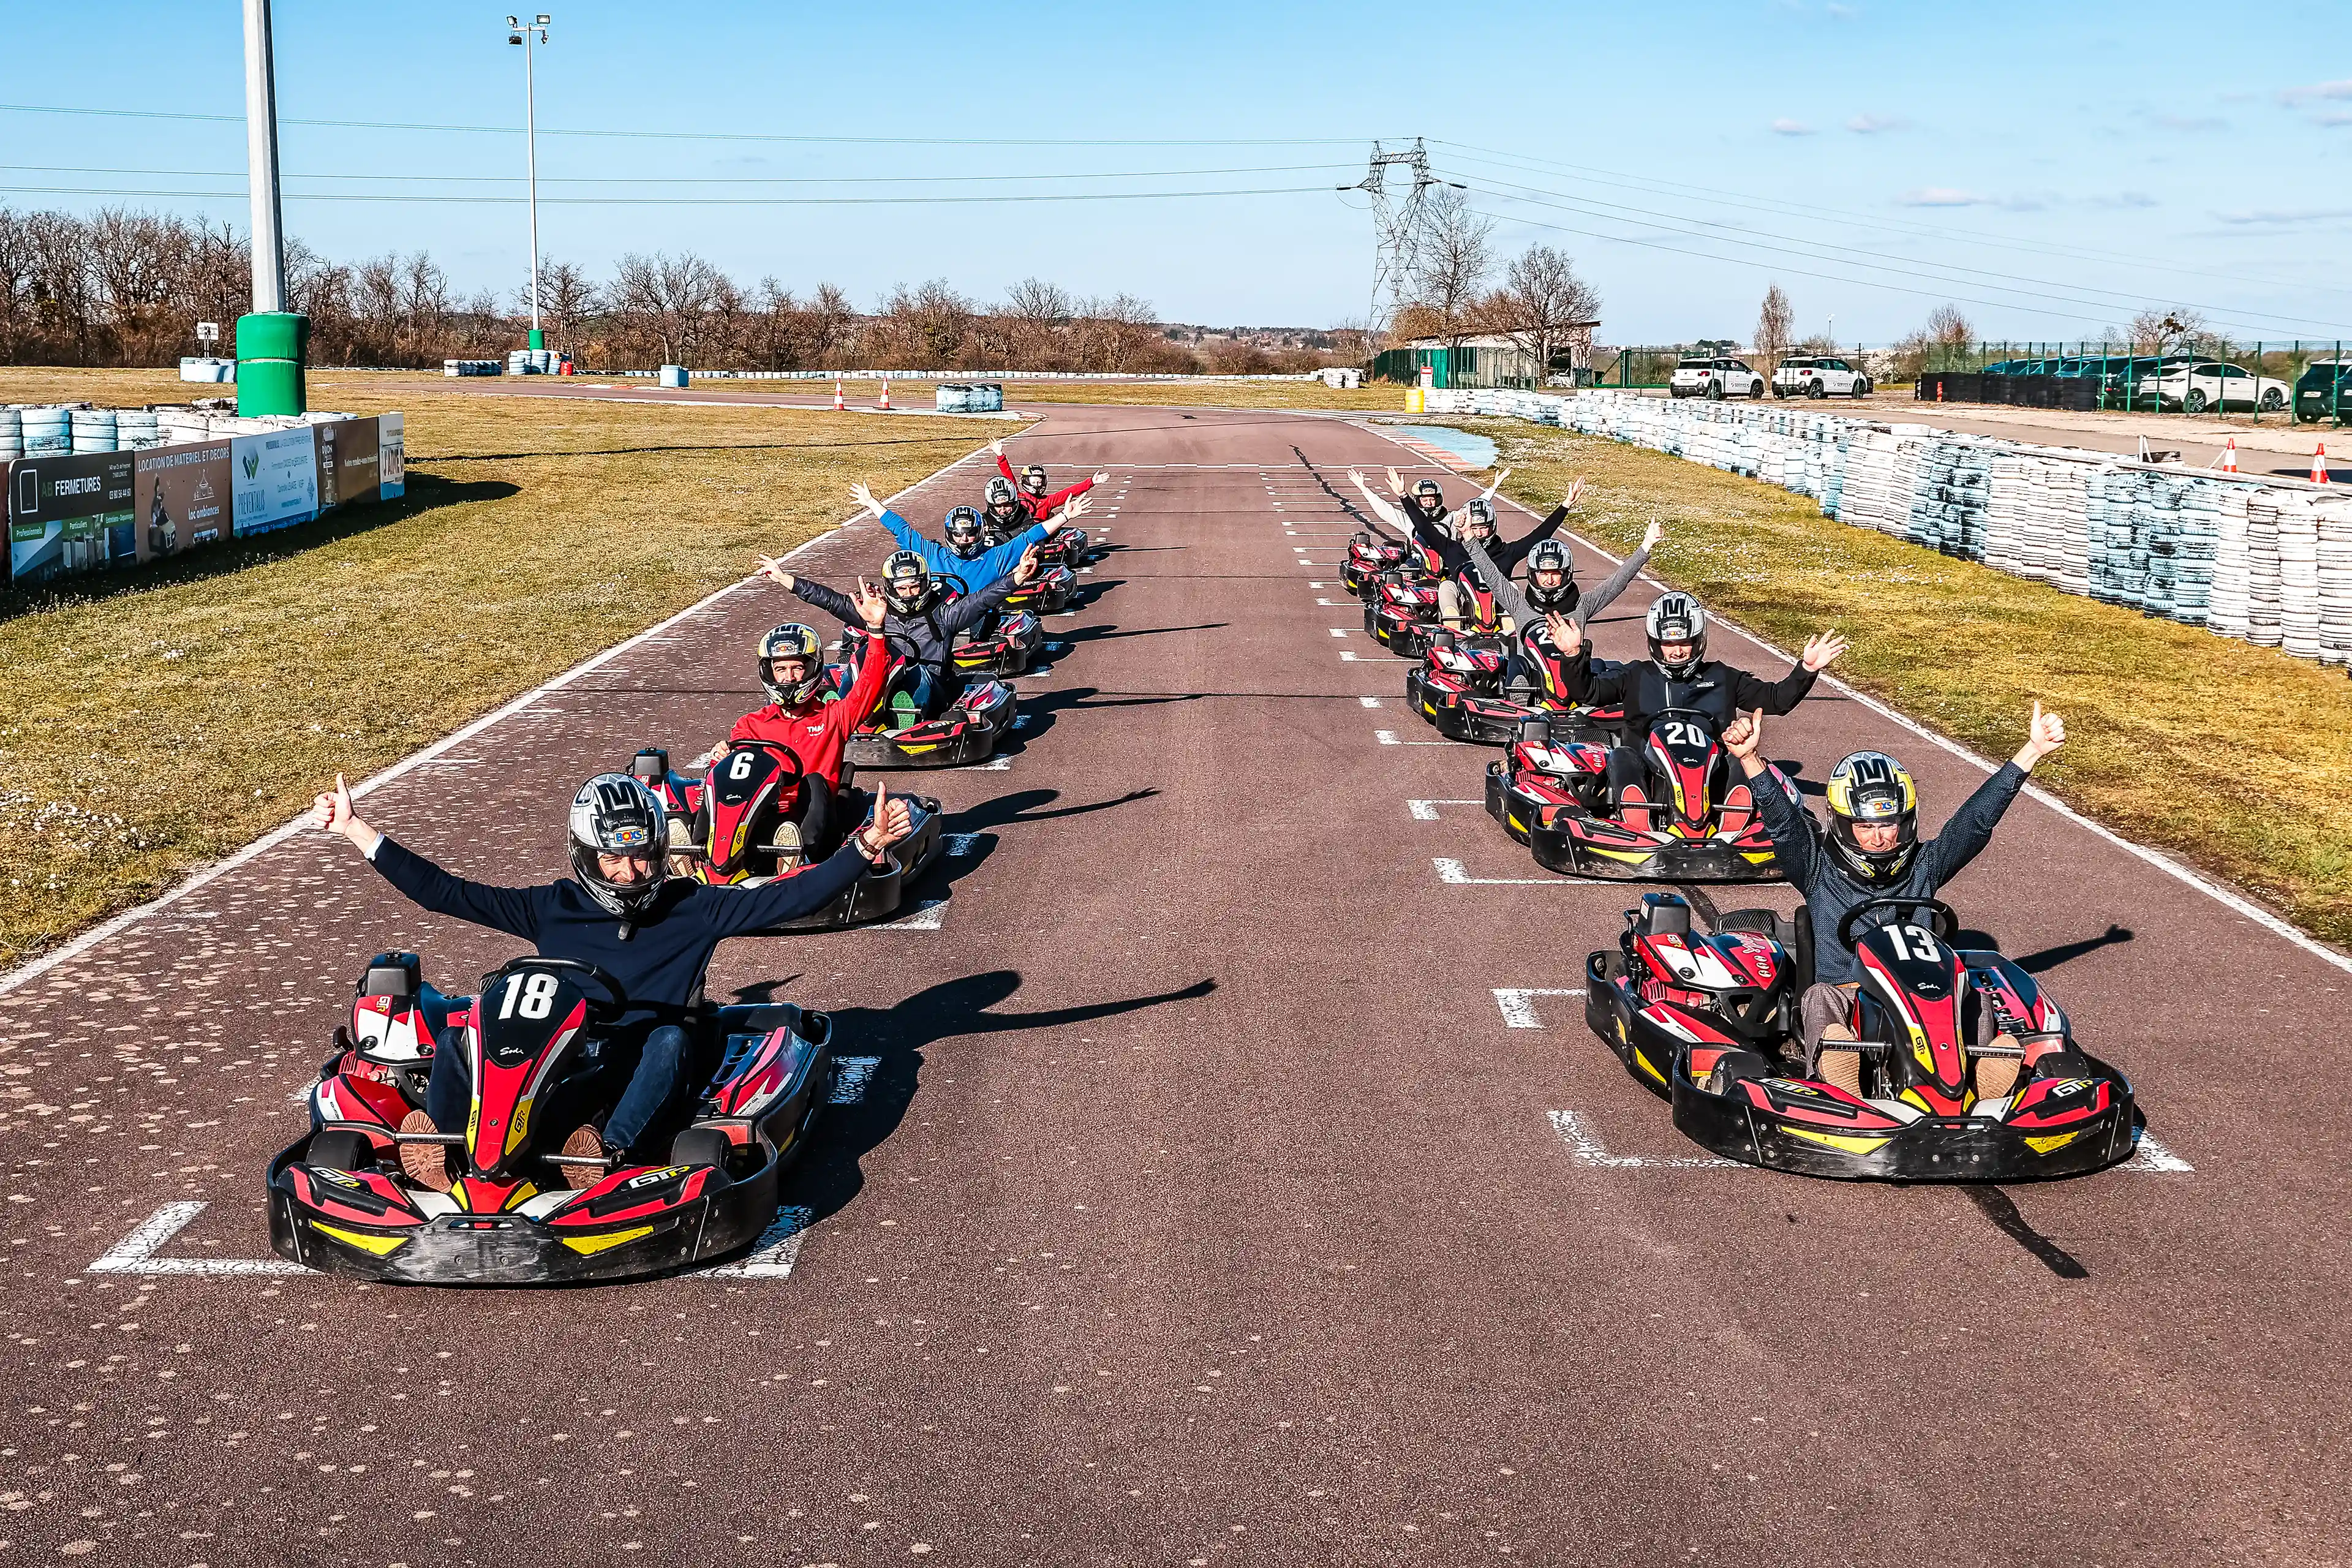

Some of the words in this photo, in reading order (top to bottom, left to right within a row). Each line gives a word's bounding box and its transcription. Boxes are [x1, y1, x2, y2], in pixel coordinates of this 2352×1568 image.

[138, 457, 165, 473] LOCATION
[166, 454, 173, 467] DE
[175, 451, 201, 466] MATERIEL
[202, 449, 209, 462] ET
[210, 447, 230, 461] DECORS
[42, 481, 53, 498] AB
[55, 475, 101, 497] FERMETURES
[1664, 722, 1706, 748] 20
[729, 752, 755, 780] 6
[1871, 801, 1893, 811] OXS
[615, 830, 643, 843] BOXS
[1882, 924, 1942, 963] 13
[498, 973, 559, 1020] 18
[1917, 982, 1941, 990] Sodi
[375, 995, 391, 1012] GTR
[499, 1047, 524, 1056] Sodi
[1915, 1035, 1924, 1055] GTR
[2052, 1079, 2094, 1098] GTR
[514, 1109, 526, 1134] GTR
[309, 1167, 361, 1188] GTR
[628, 1166, 691, 1189] GTR
